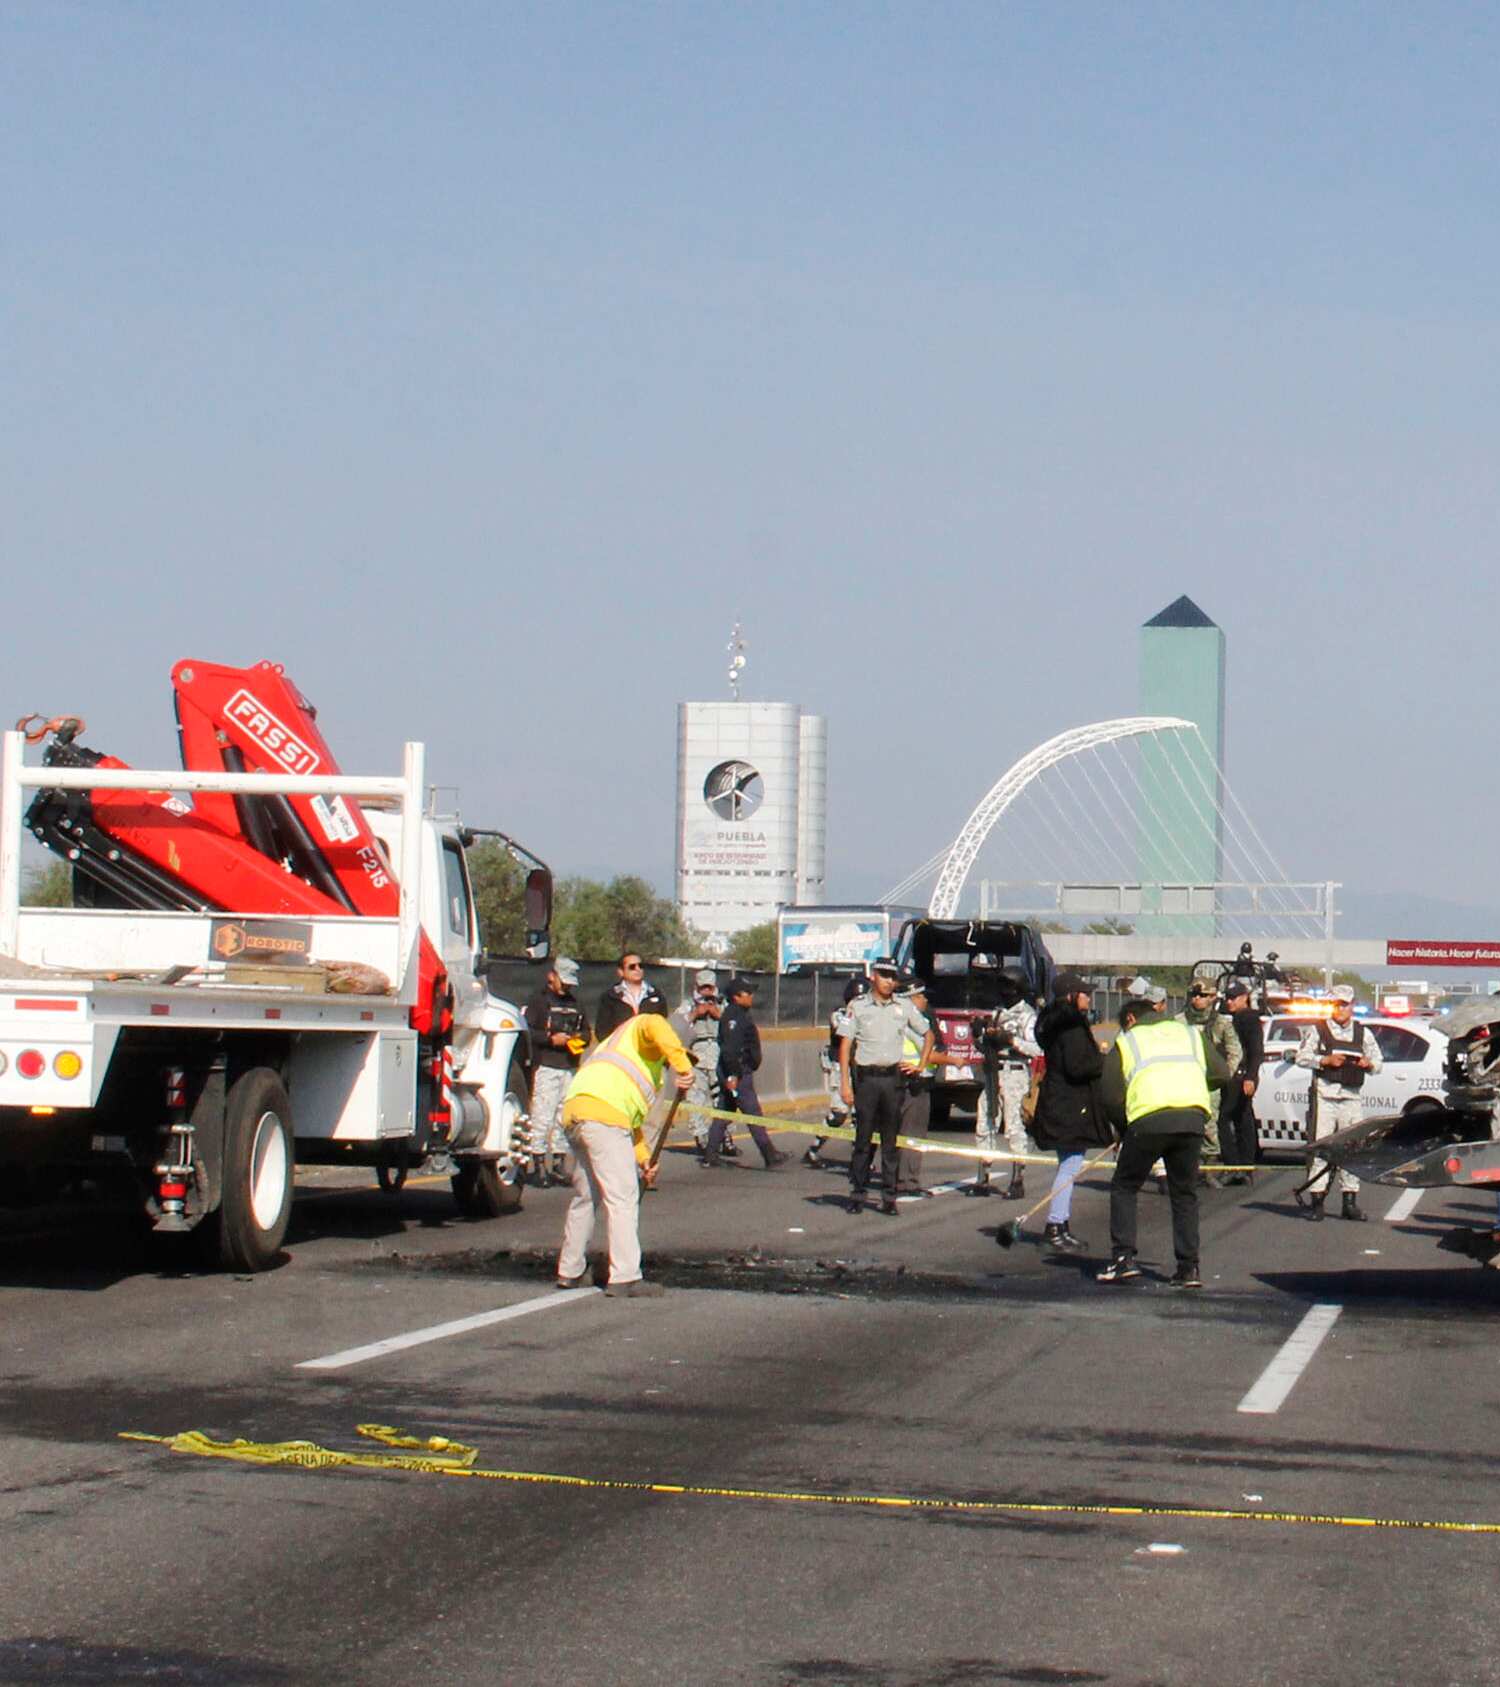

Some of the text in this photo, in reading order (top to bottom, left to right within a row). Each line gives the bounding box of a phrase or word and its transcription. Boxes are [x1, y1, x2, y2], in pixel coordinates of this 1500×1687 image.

[234, 700, 309, 771] FASSI
[717, 831, 766, 841] PUEBLA
[1388, 948, 1414, 957] Hacer
[1449, 949, 1474, 957] Hacer
[1274, 1091, 1310, 1104] GUARD
